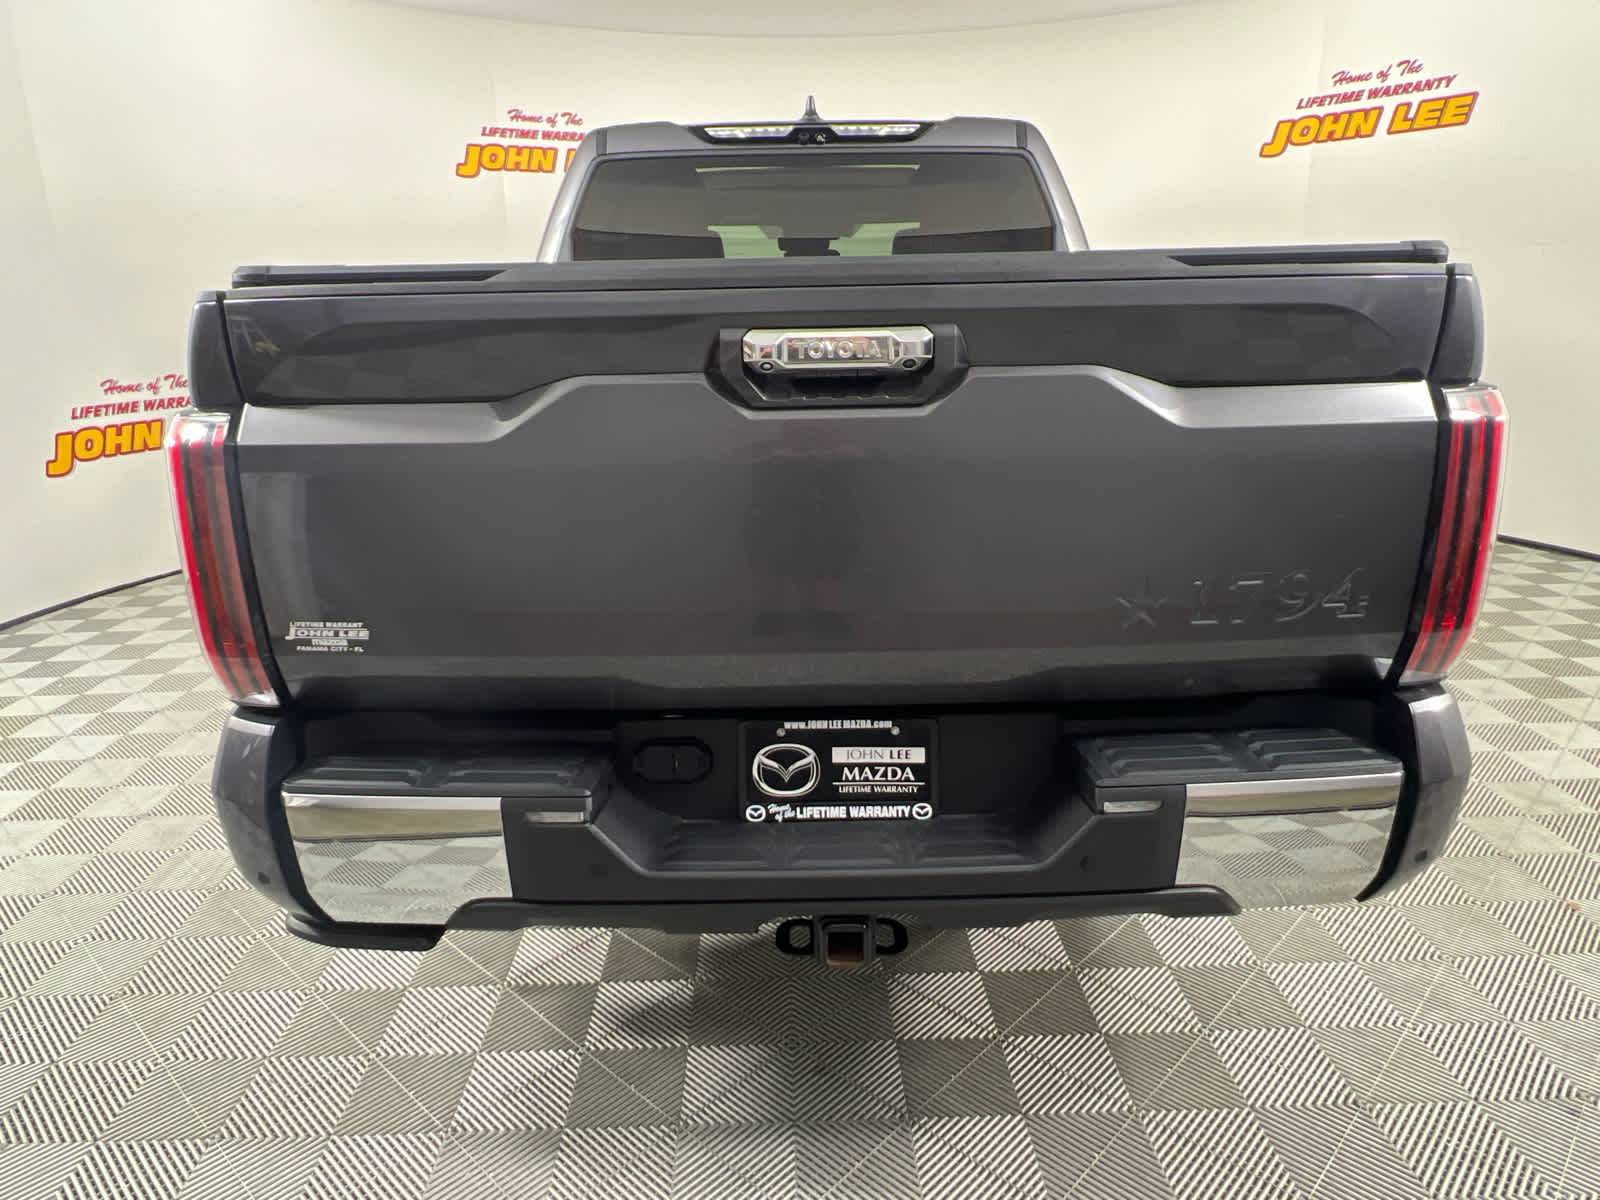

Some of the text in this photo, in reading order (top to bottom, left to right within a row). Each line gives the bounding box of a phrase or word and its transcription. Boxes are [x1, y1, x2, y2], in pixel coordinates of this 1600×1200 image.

[1331, 58, 1424, 86] Home of The
[1296, 74, 1458, 110] LIFETIME WARRANTY
[507, 108, 583, 127] Home of The
[1259, 91, 1479, 158] JOHN LEE
[481, 126, 539, 139] LIFETIME
[456, 143, 558, 178] JOHN
[793, 340, 881, 359] TOYOTA
[100, 374, 188, 395] Home of The
[71, 400, 139, 420] LIFETIME
[46, 418, 165, 478] JOHN
[1190, 567, 1368, 625] 1794
[845, 749, 912, 761] JOHN LEE
[841, 766, 915, 781] MAZDA
[838, 785, 918, 793] LIFETIME WARRANTY
[796, 805, 911, 819] LIFETIME WARRANTY
